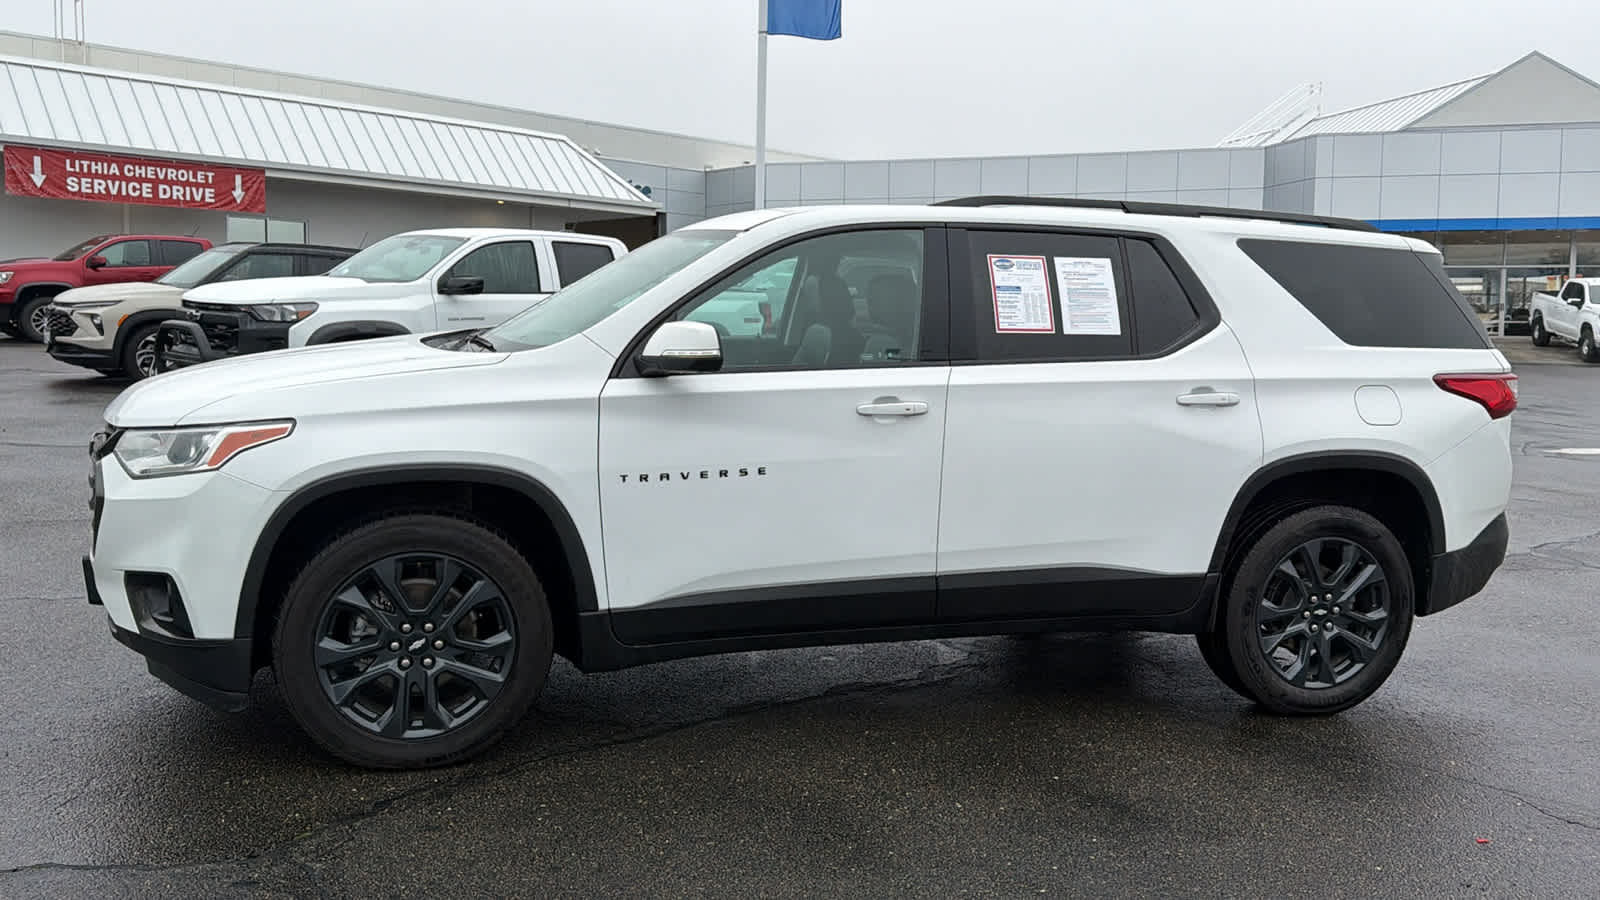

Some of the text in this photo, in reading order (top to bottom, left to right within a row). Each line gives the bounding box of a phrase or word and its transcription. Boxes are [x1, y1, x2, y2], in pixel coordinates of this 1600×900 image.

[65, 159, 215, 184] LITHIA CHEVROLET
[66, 177, 216, 203] SERVICE DRIVE
[619, 466, 767, 483] TRAVERSE
